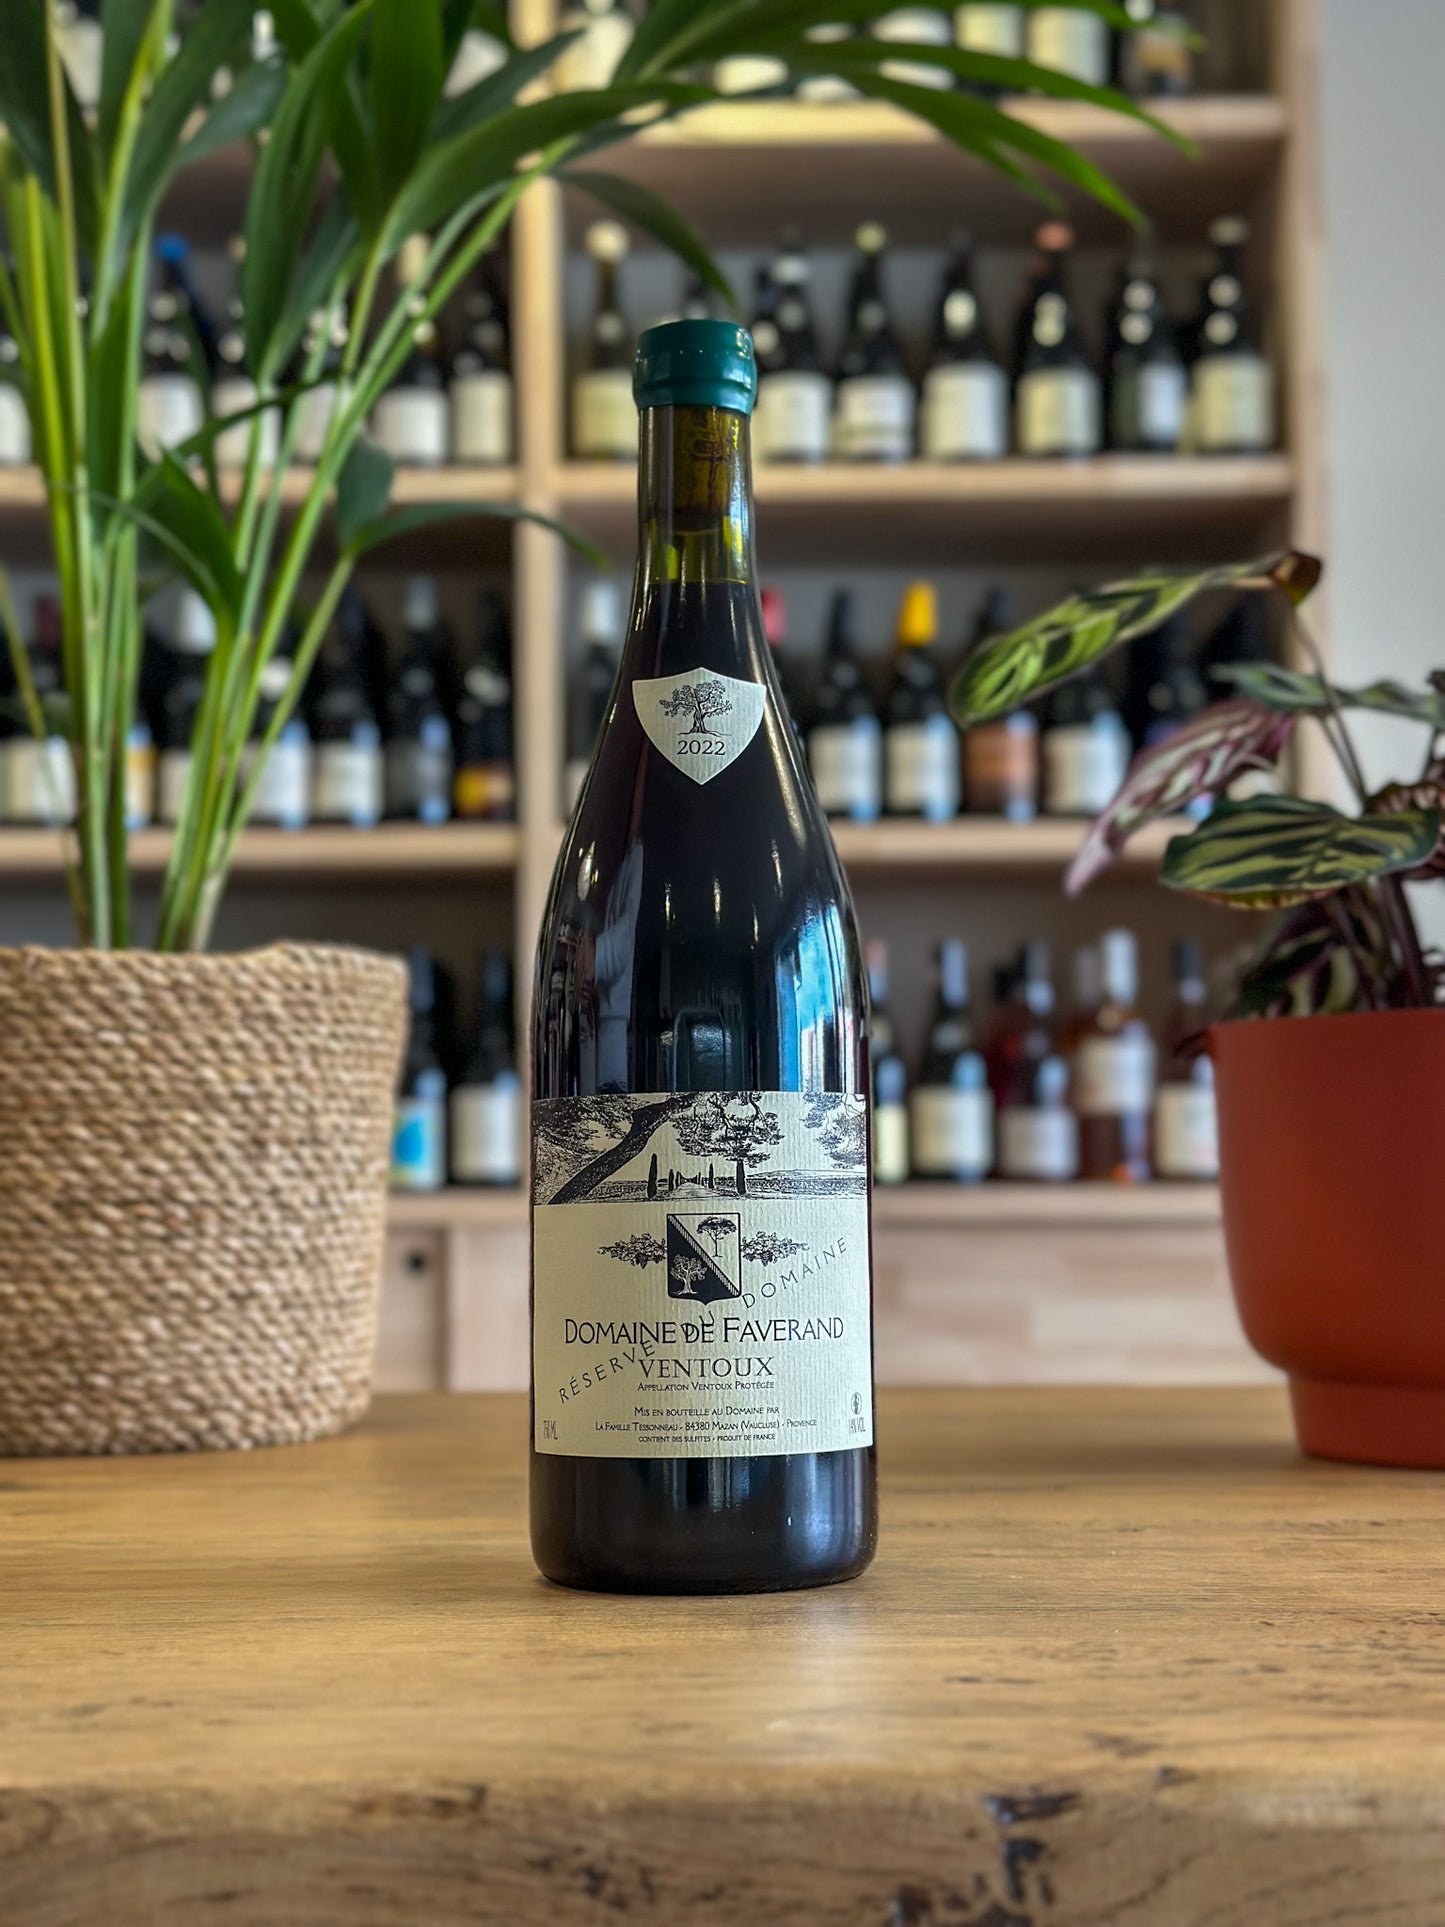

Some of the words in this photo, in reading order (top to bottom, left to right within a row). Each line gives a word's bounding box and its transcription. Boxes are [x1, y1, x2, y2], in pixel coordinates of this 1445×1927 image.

[677, 740, 726, 755] 2022
[558, 1340, 655, 1403] RÉSERVE
[741, 1237, 847, 1308] DOMAINE
[637, 1357, 775, 1378] VENTOUX
[652, 1408, 663, 1416] EN
[666, 1408, 710, 1416] BOUTEILLE
[711, 1408, 723, 1416] AU
[766, 1406, 780, 1415] PAR
[685, 1420, 710, 1431] 84380
